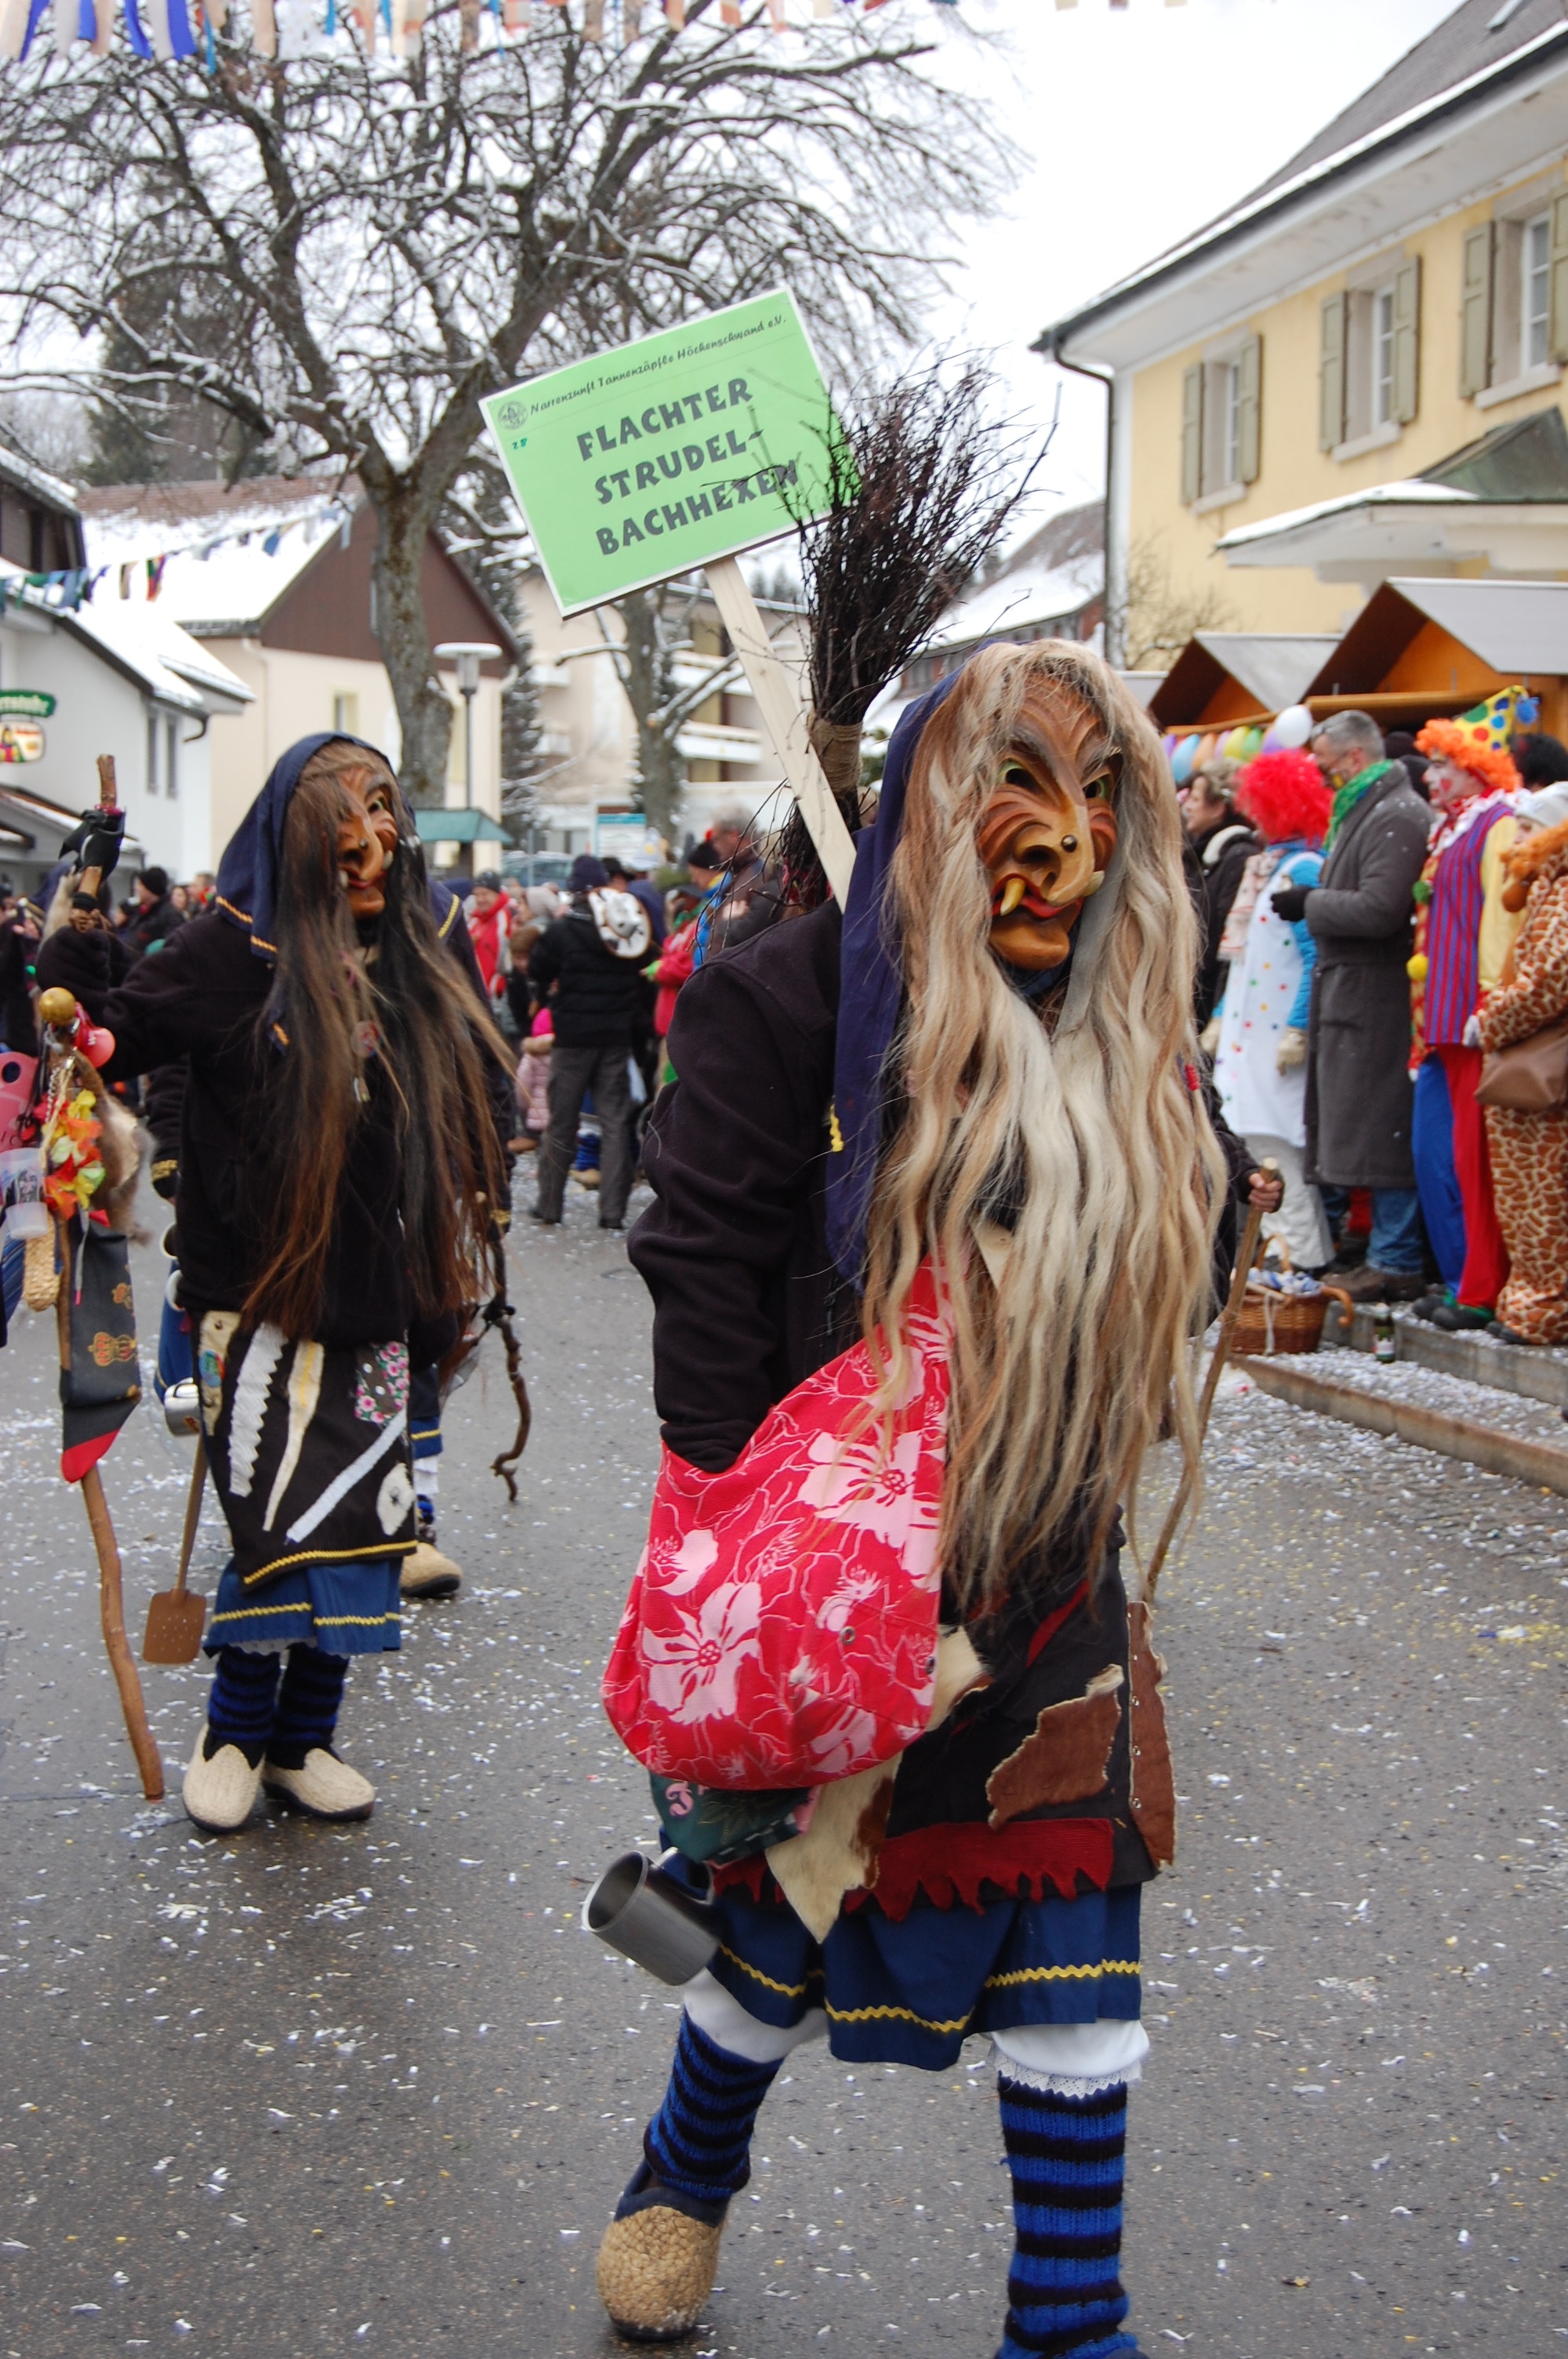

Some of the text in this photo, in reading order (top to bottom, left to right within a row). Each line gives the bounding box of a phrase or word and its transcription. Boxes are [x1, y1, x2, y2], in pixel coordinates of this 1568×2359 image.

[530, 314, 787, 416] Narrenzunft Tannenzäpfle Höchenschwand e.V.
[576, 377, 753, 462] FLACHTER
[594, 428, 765, 505] STRUDEL-
[595, 459, 800, 555] BACHHEXEN
